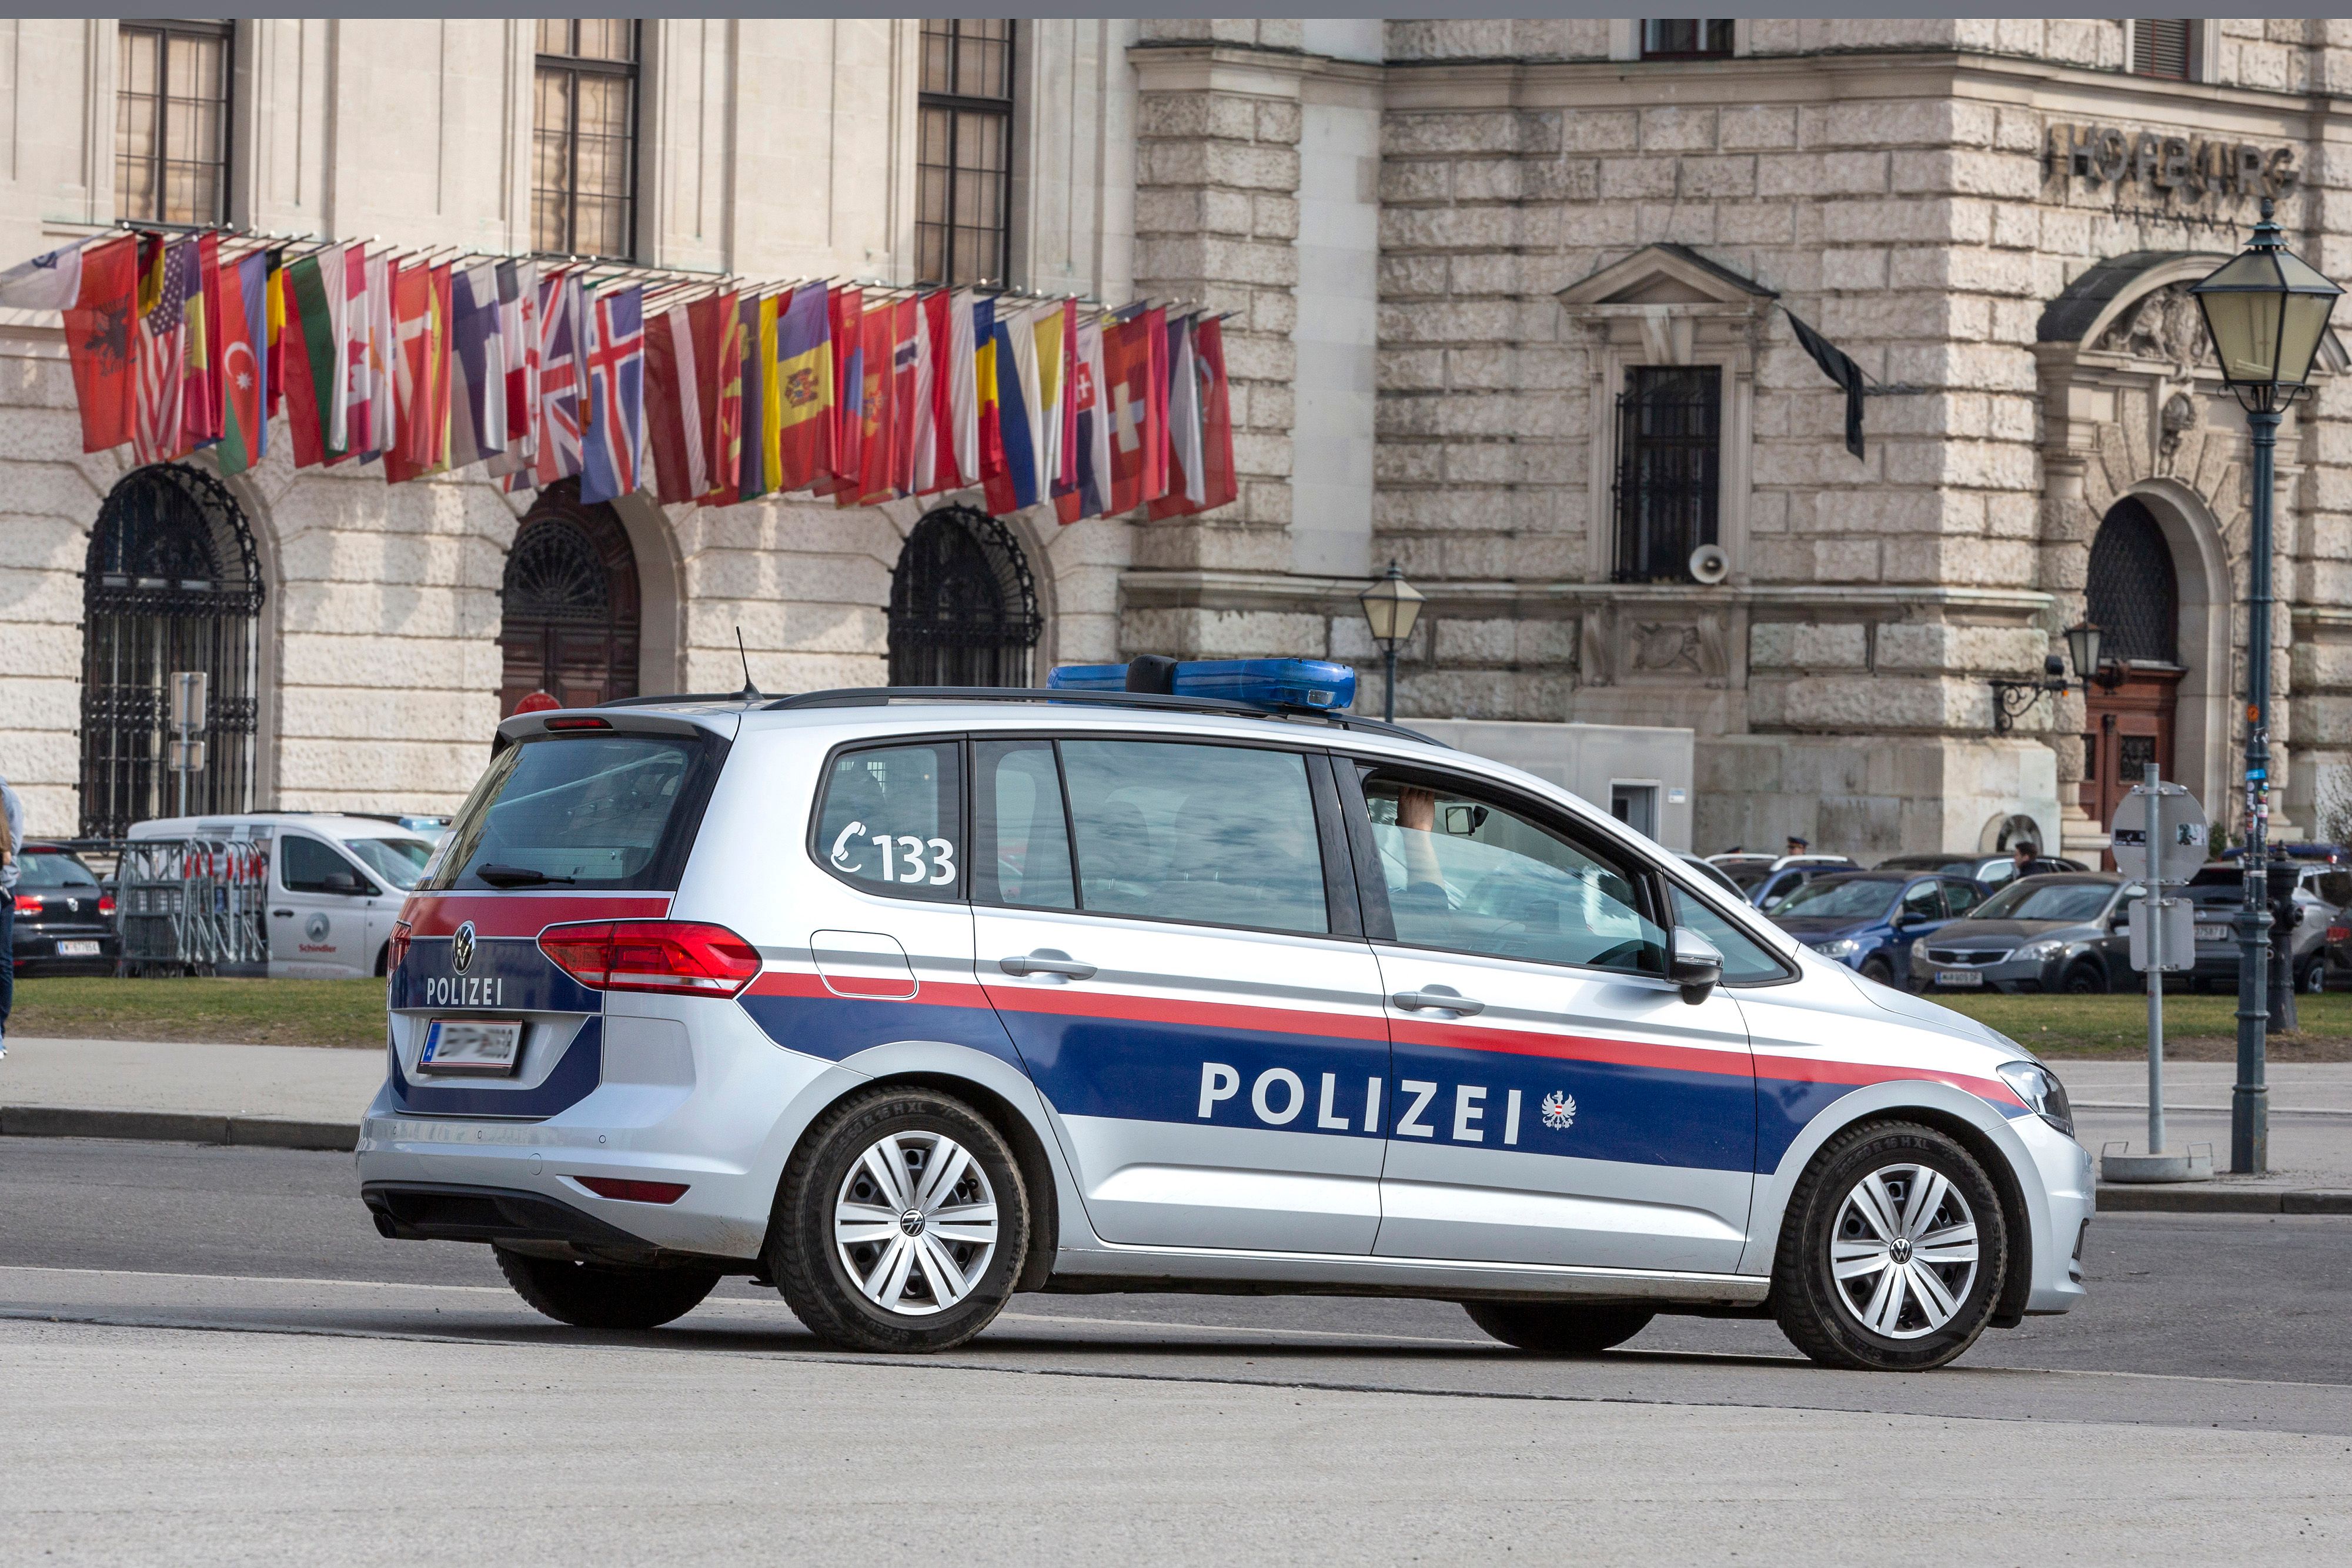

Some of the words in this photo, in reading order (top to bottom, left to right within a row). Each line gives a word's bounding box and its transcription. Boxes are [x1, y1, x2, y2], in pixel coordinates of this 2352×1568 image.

[2110, 203, 2239, 236] VIENNA
[871, 834, 957, 885] 133
[426, 977, 502, 1005] POLIZEI
[426, 1047, 432, 1057] A
[1197, 1061, 1522, 1145] POLIZEI
